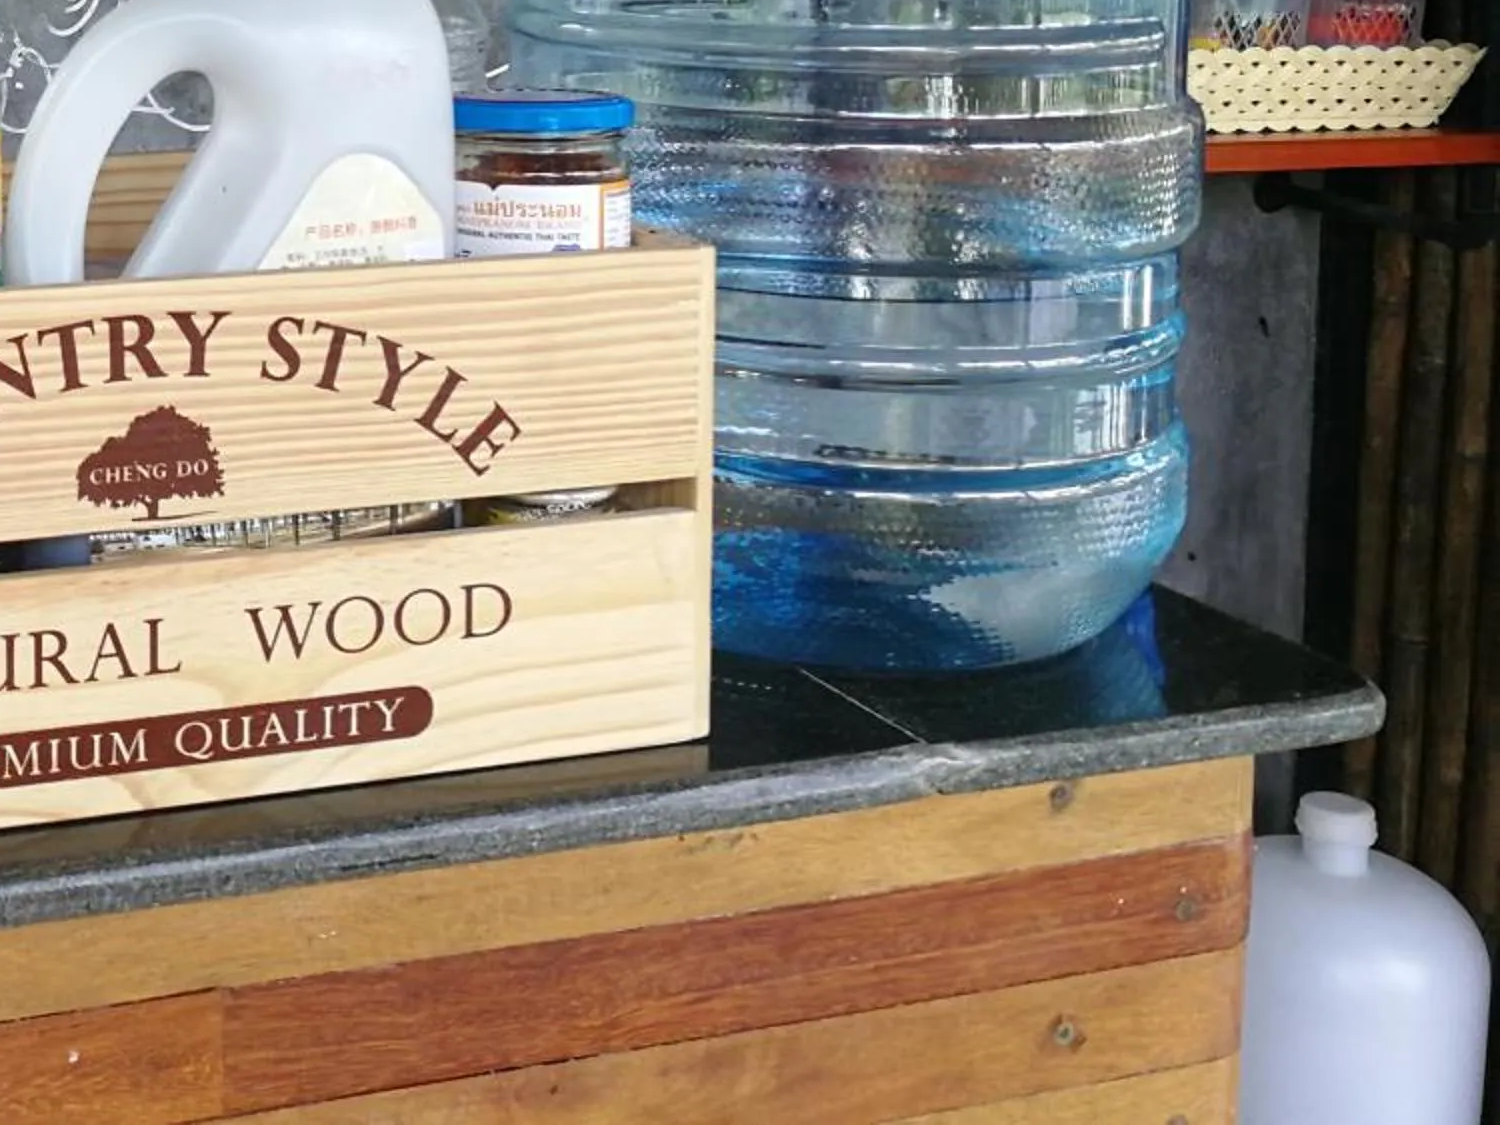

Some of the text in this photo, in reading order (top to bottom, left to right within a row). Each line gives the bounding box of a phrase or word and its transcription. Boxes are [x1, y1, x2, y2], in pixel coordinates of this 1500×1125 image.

[473, 196, 581, 217] แม่ประนอม
[260, 316, 522, 476] STYLE
[89, 458, 209, 486] CHENG DO
[244, 582, 513, 663] WOOD
[174, 696, 406, 760] QUALITY
